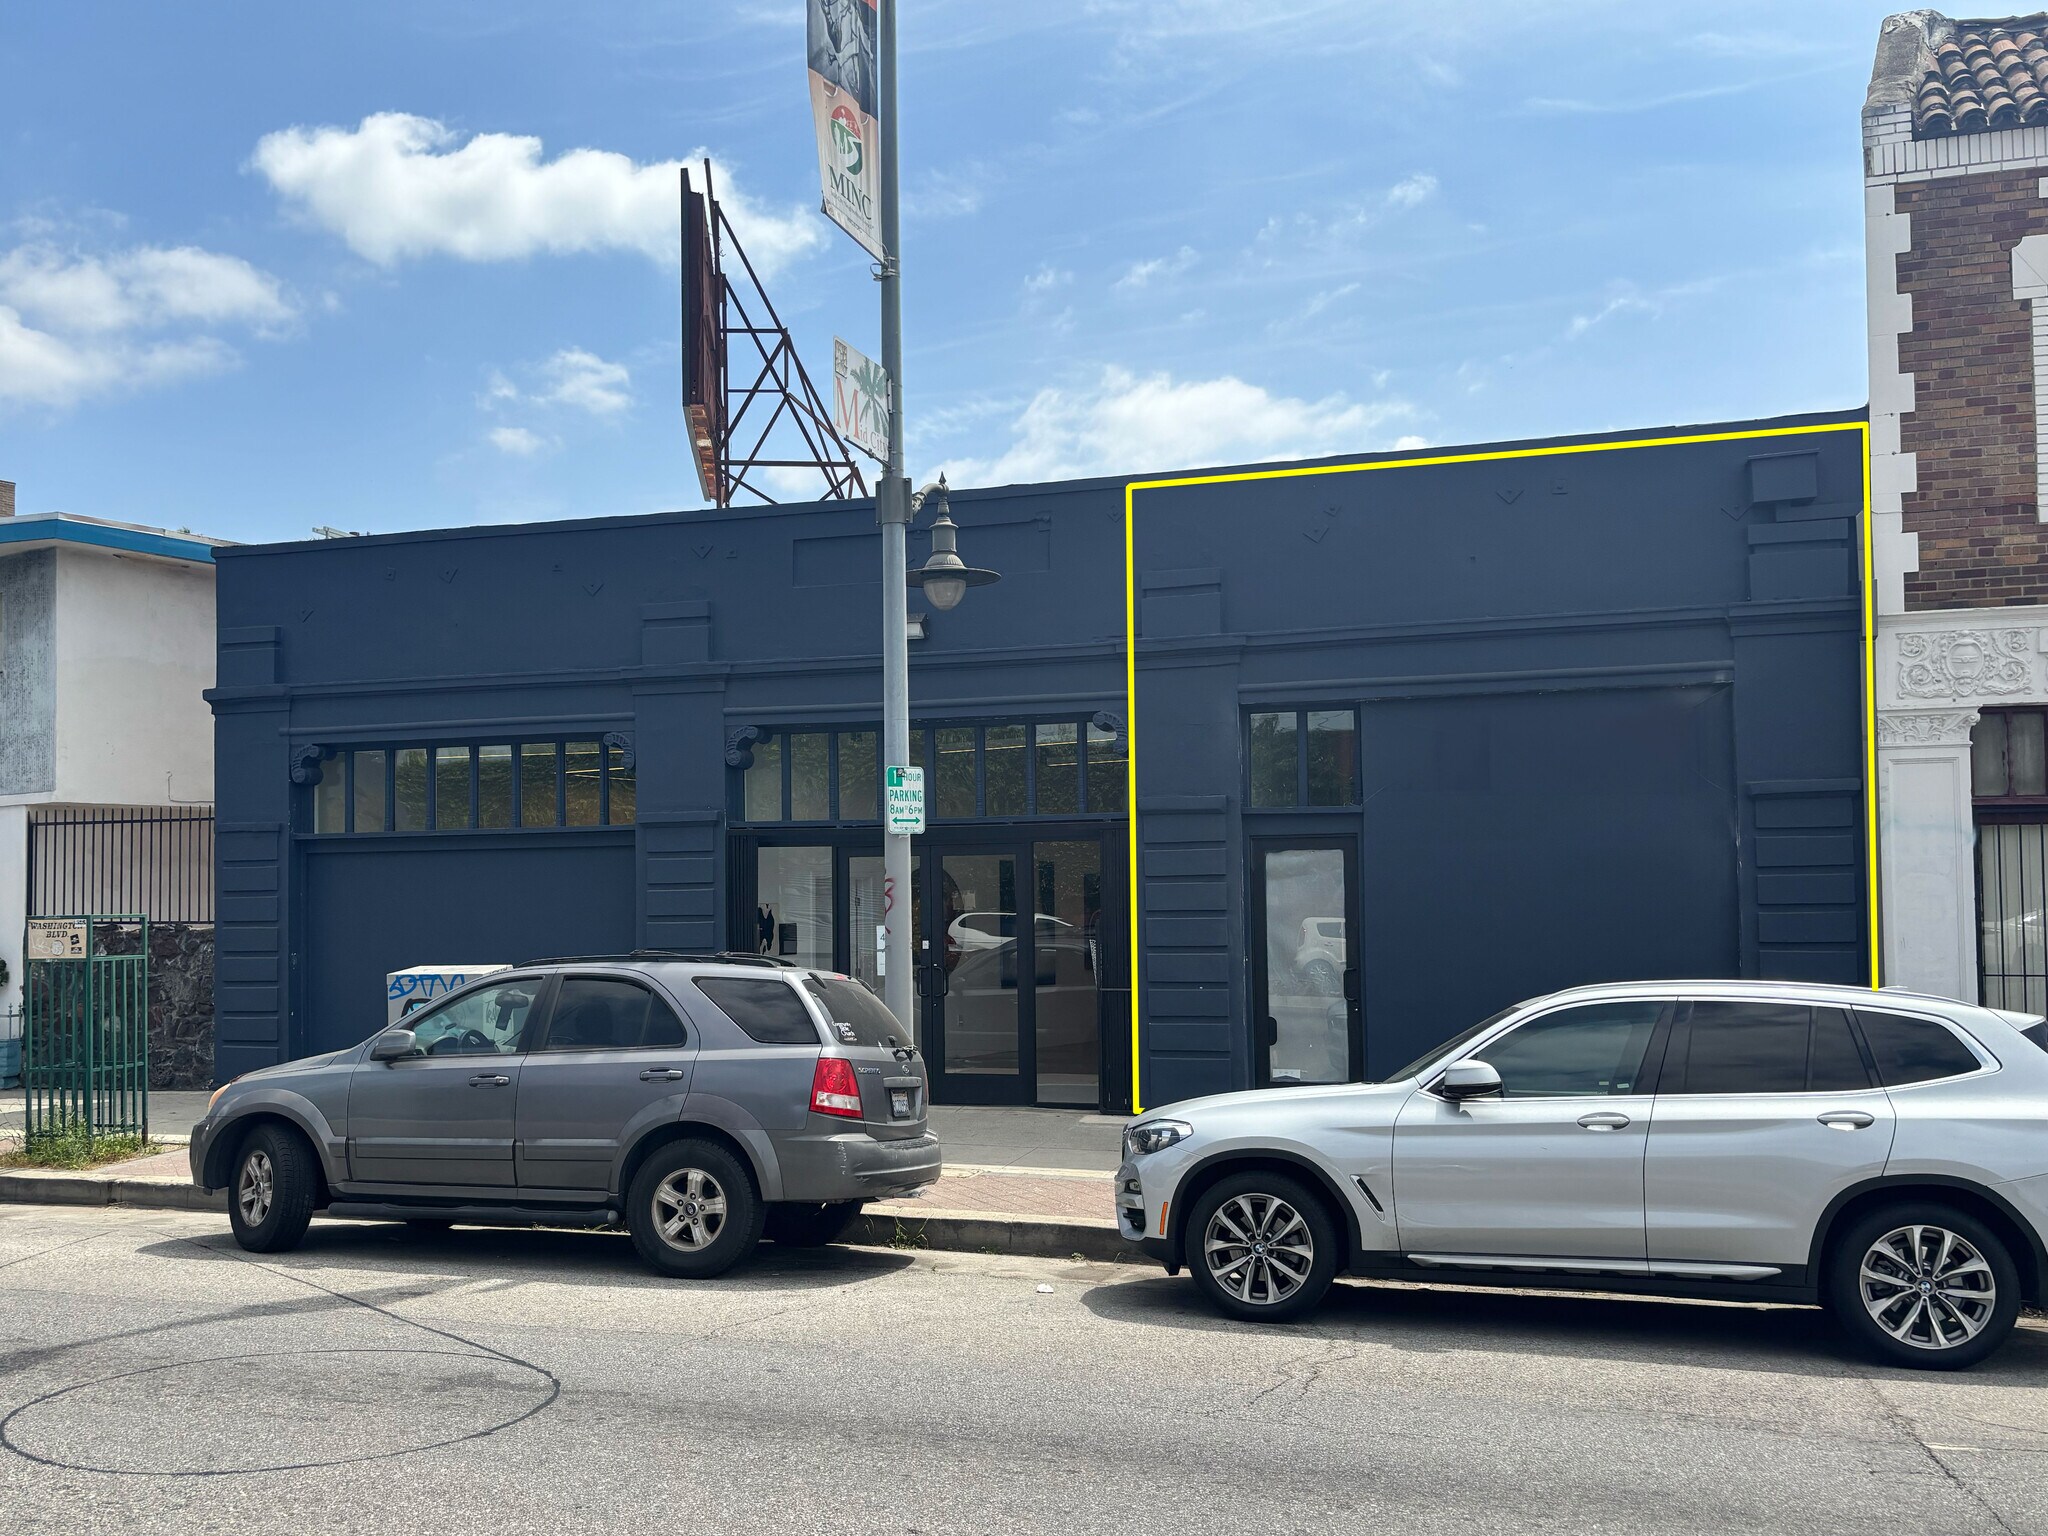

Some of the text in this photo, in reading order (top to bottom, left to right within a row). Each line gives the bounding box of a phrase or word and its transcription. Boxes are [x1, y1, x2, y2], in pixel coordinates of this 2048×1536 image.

[828, 164, 872, 220] MINC
[836, 376, 888, 459] Mid City
[904, 773, 921, 781] HOUR
[889, 789, 922, 802] PARKING
[889, 804, 904, 814] 8AM
[908, 804, 922, 814] 6PM
[31, 922, 83, 930] WASHINGTO
[45, 930, 70, 938] BLVD.
